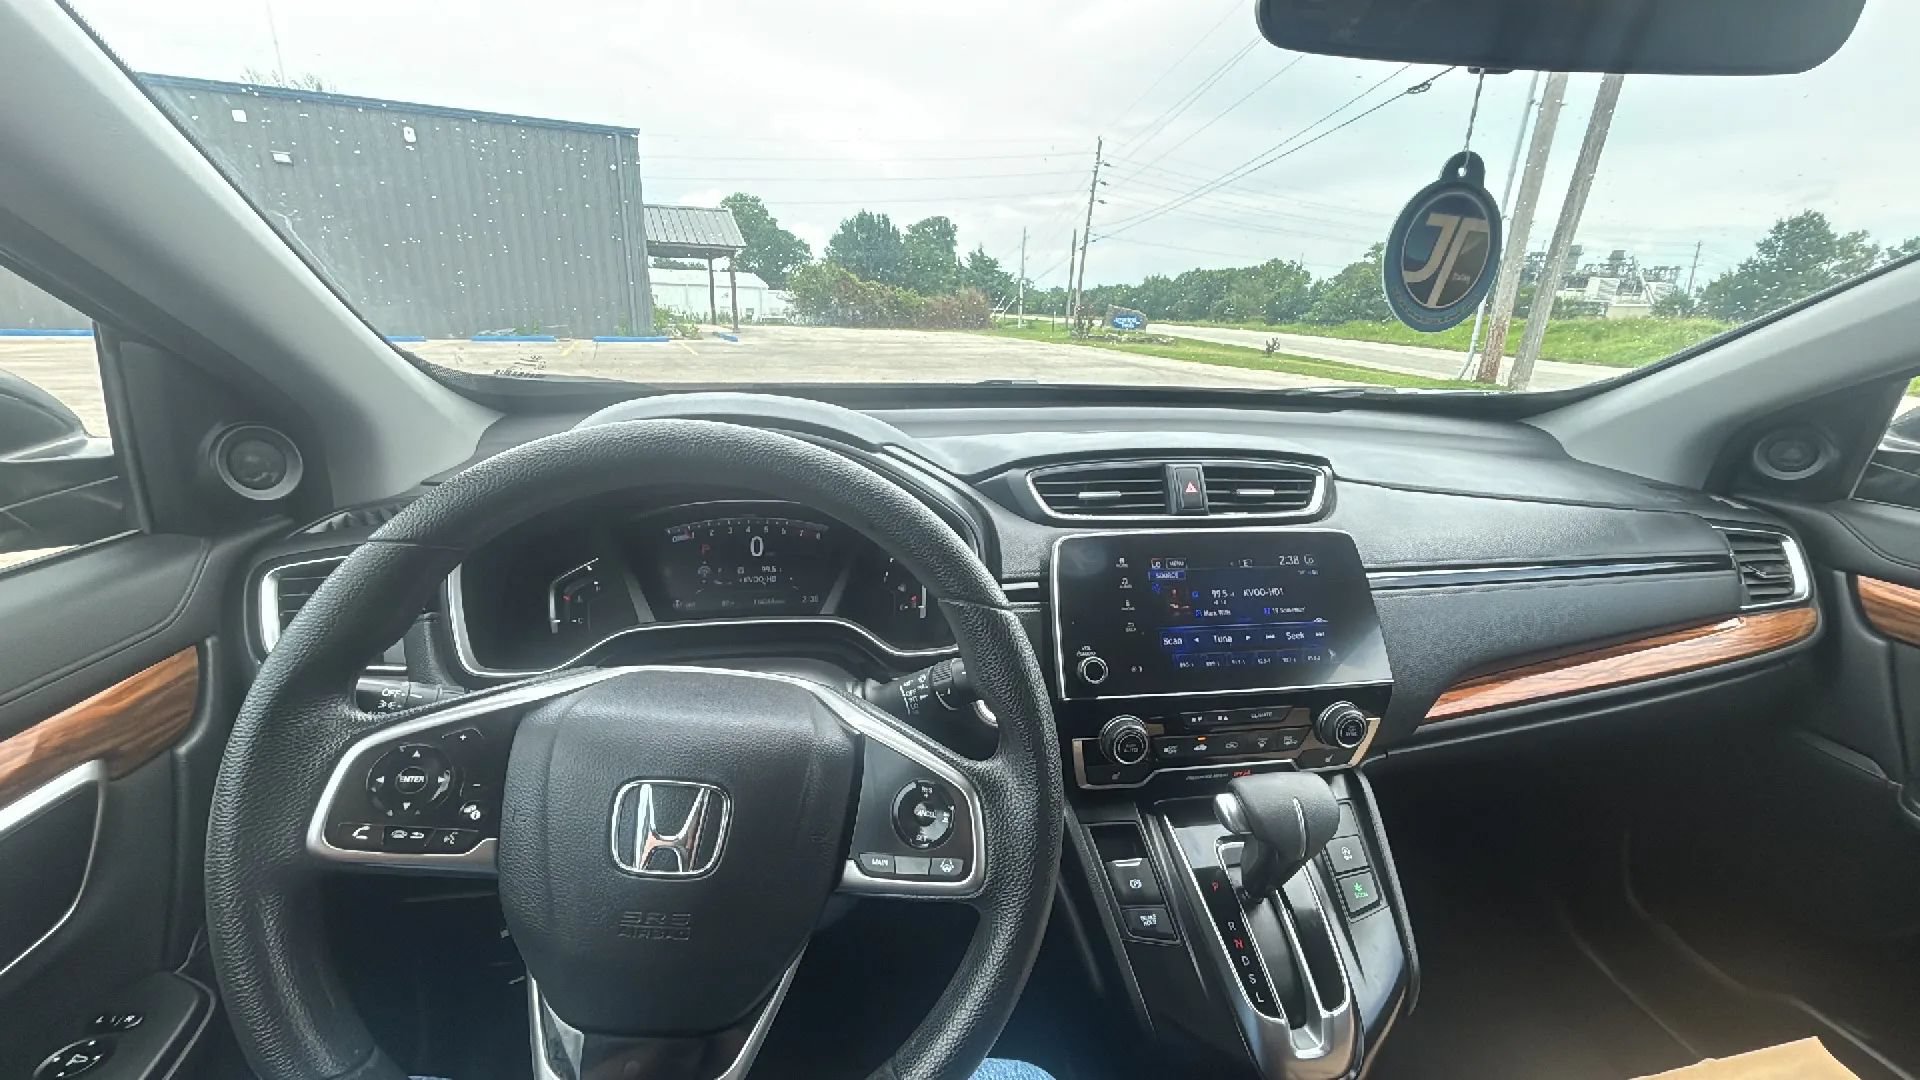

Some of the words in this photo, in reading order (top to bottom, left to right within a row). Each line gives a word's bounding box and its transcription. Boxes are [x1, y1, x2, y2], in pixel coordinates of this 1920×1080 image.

[750, 535, 764, 557] 0
[1163, 638, 1183, 646] Scan
[1285, 631, 1305, 640] Seek
[381, 687, 402, 698] OFF
[399, 774, 425, 783] ENTER
